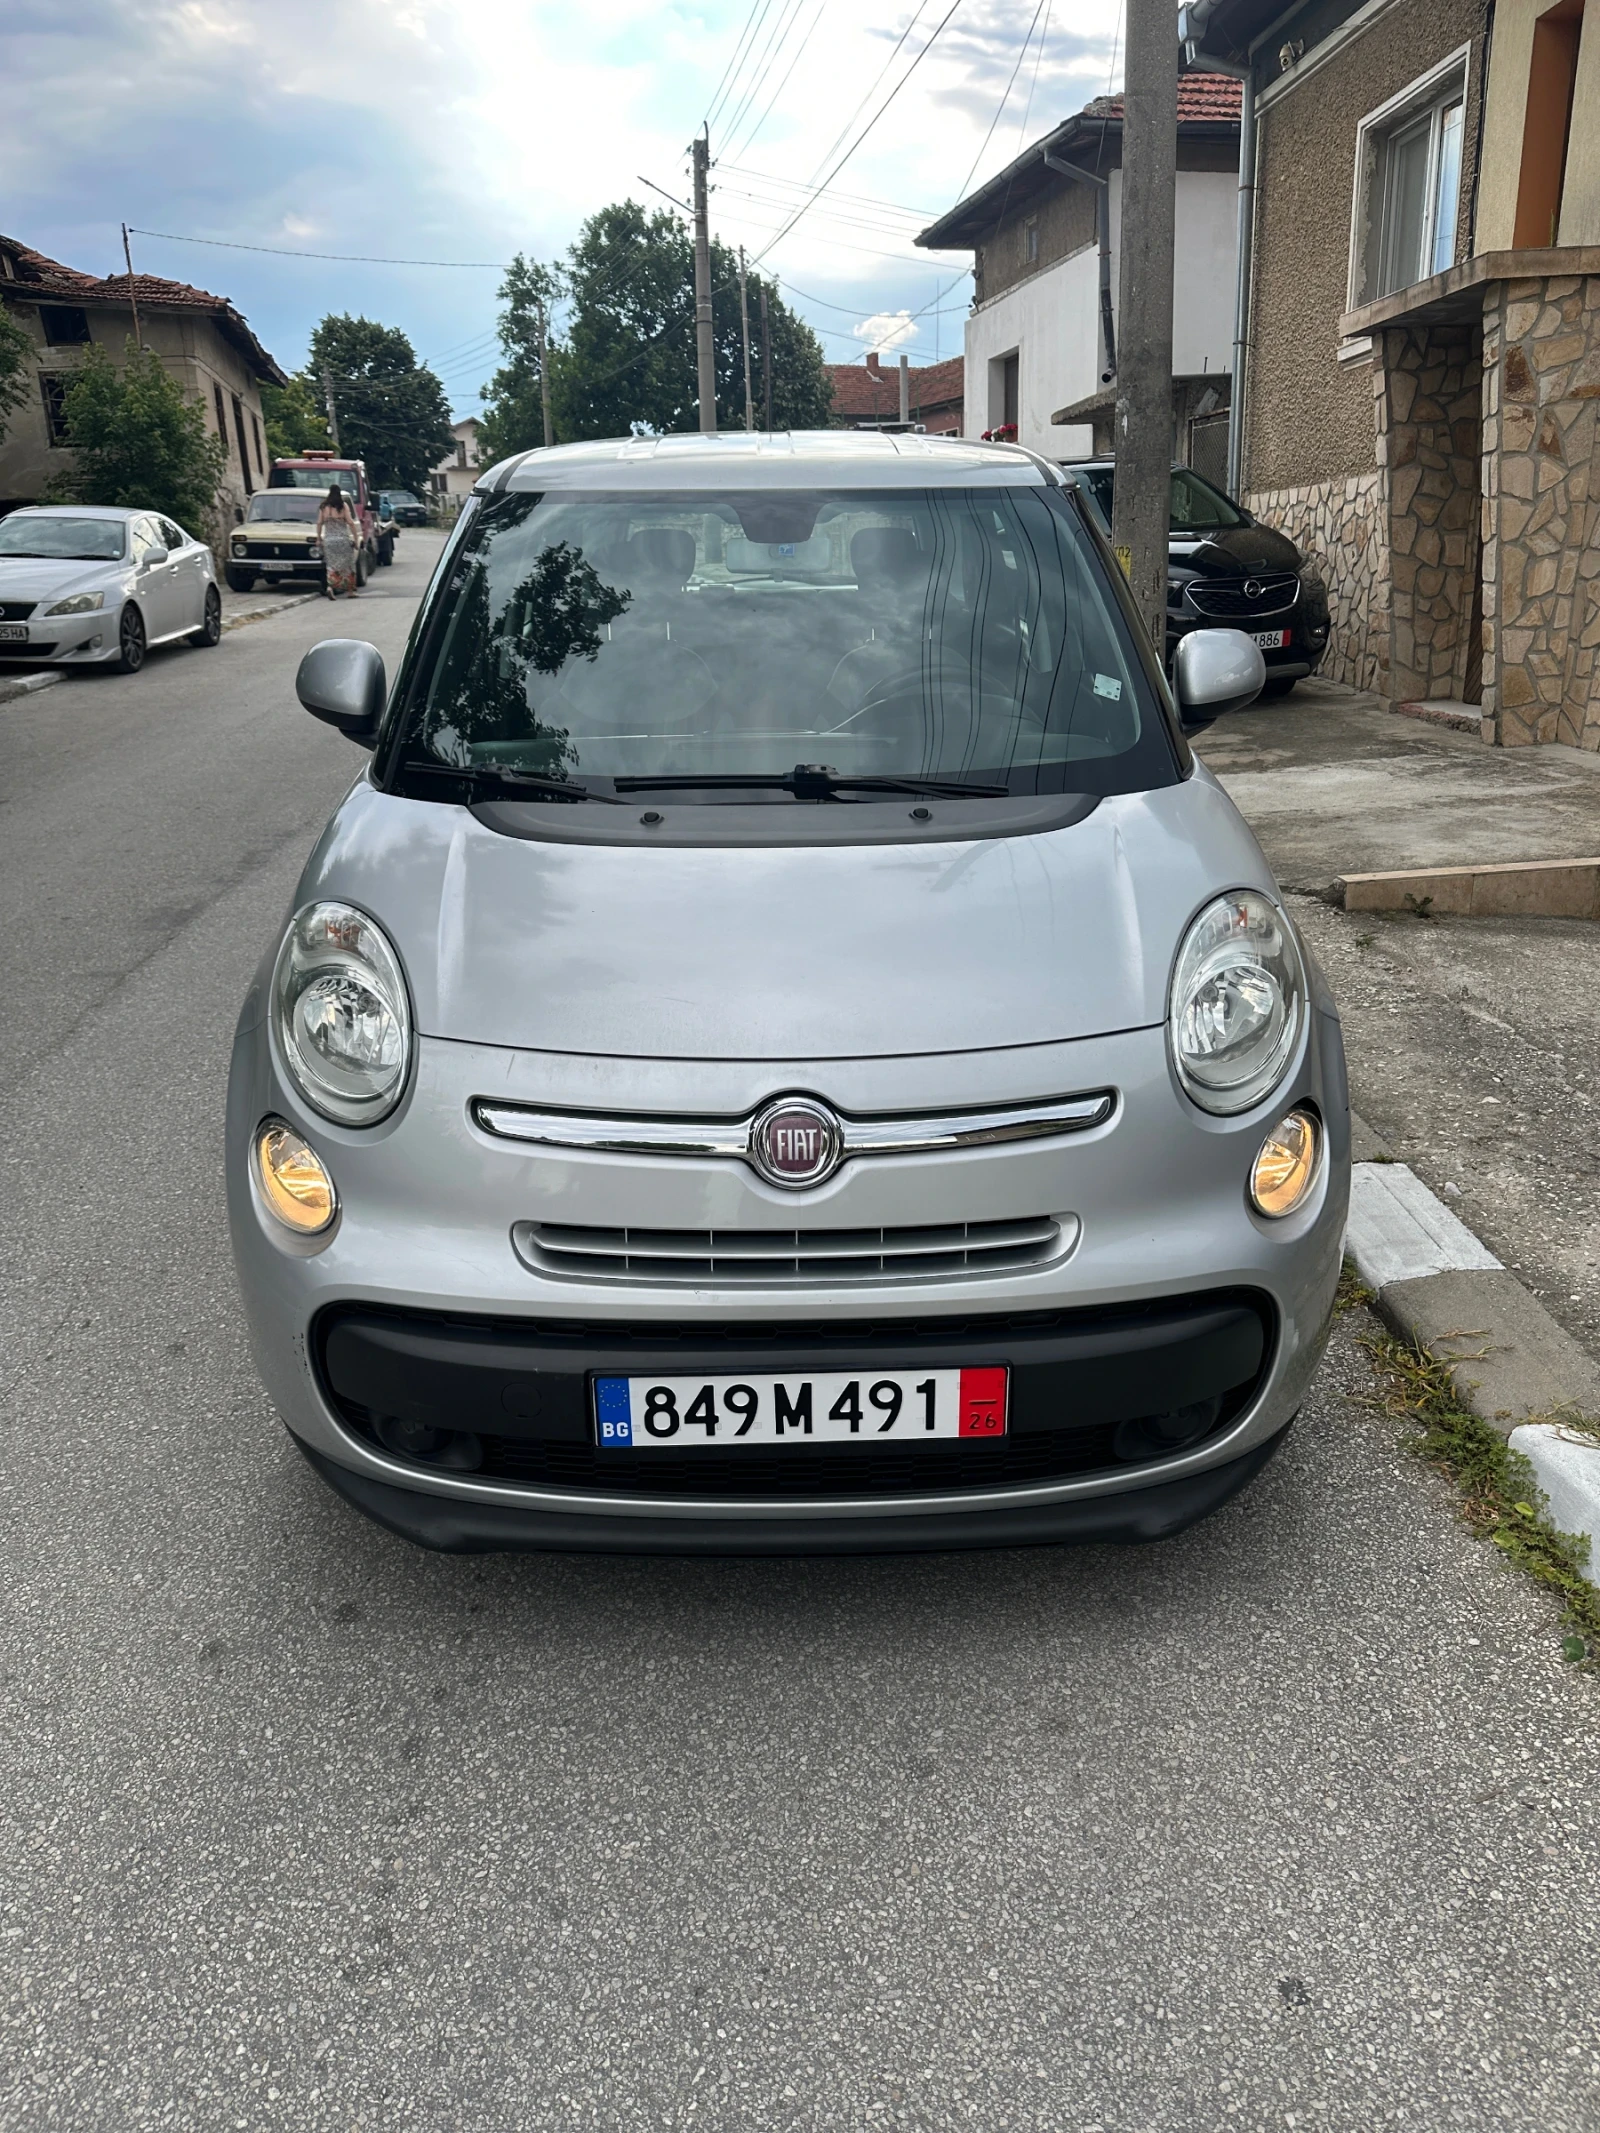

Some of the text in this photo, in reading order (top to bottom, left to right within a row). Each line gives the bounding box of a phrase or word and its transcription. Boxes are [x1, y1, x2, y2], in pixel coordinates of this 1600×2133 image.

[1259, 632, 1280, 648] 886
[777, 1129, 818, 1161] FIAT
[644, 1379, 936, 1438] 849 M 491
[602, 1422, 629, 1438] BG
[969, 1411, 997, 1430] 26
